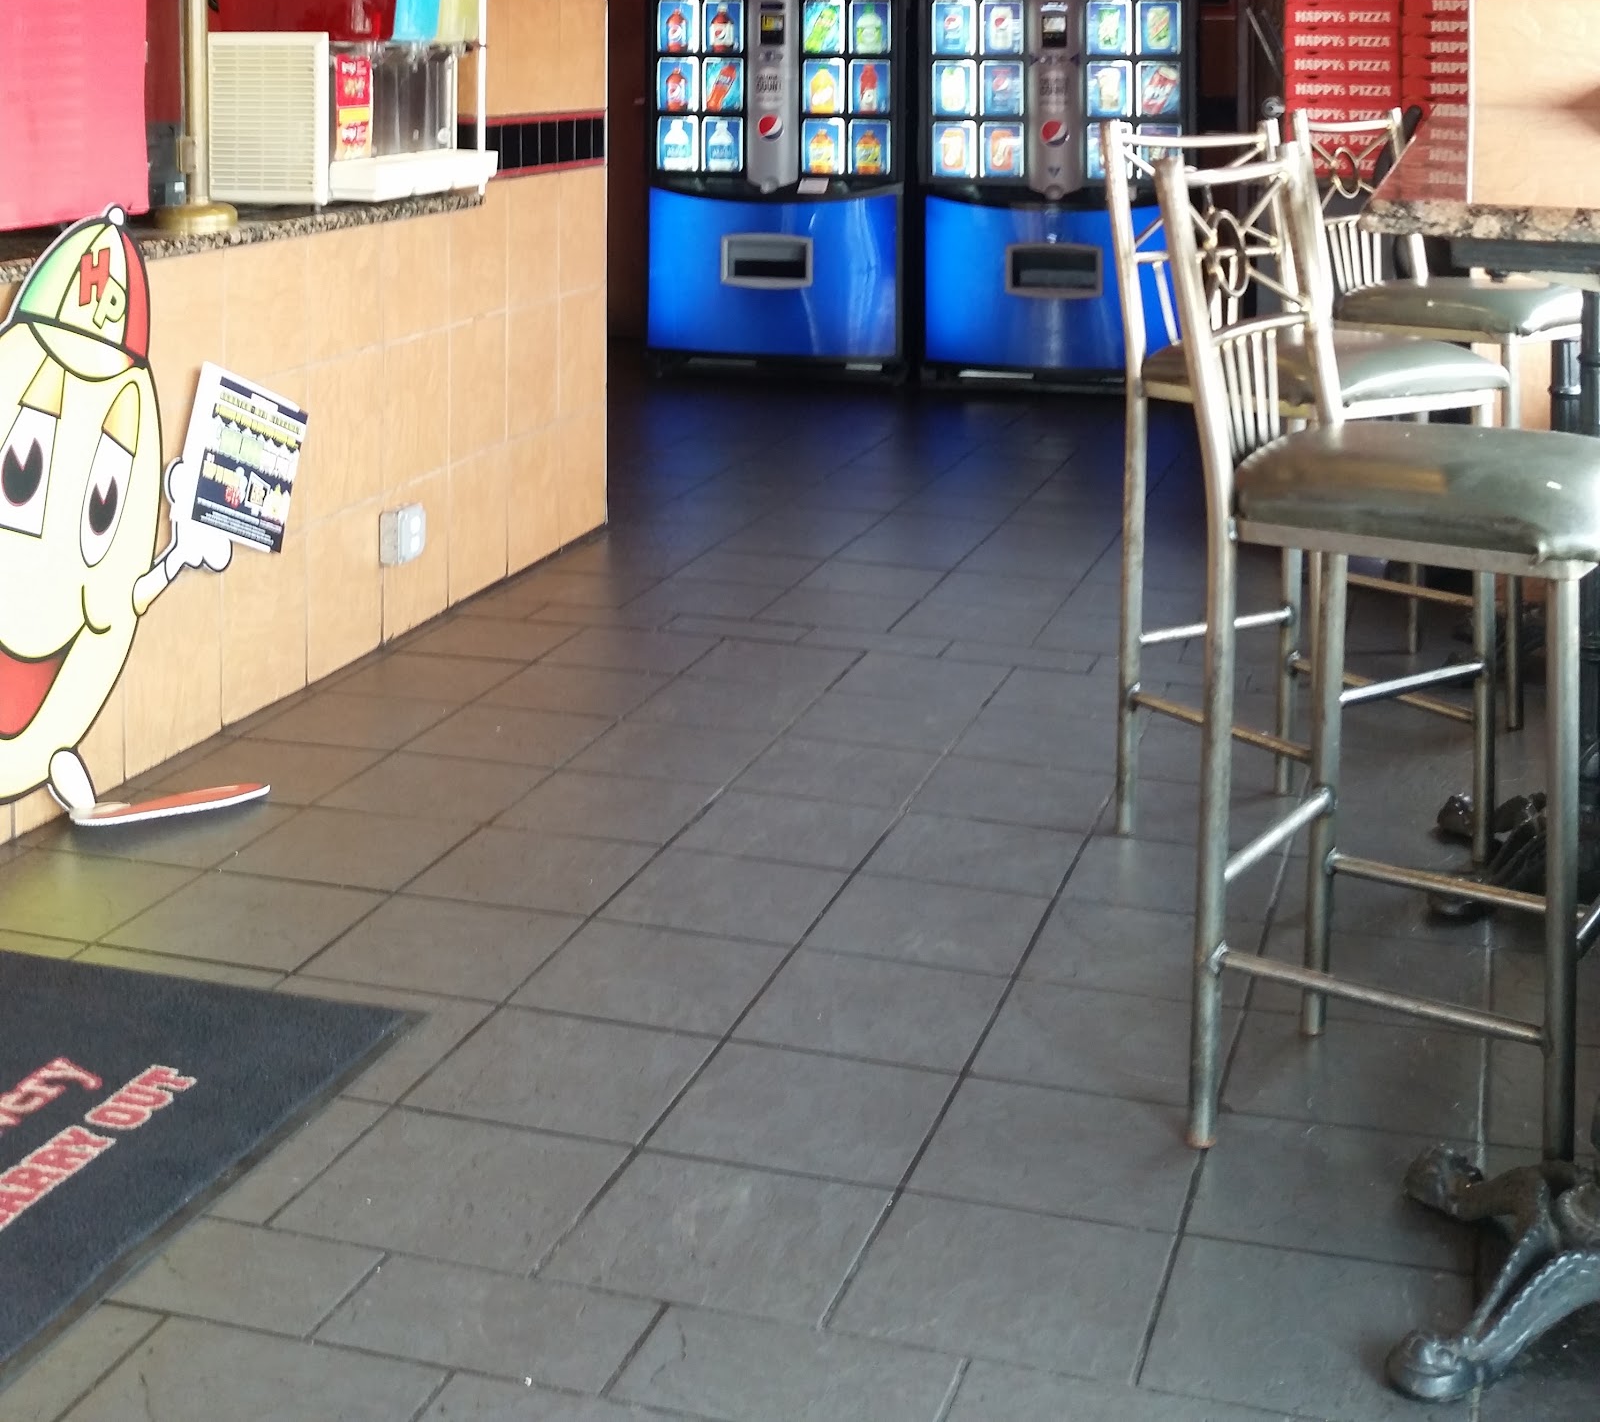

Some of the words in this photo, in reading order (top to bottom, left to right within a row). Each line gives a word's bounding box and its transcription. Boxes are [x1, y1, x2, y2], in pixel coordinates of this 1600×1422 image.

[1432, 0, 1469, 11] HAPP
[1349, 11, 1391, 23] PIZZA
[1431, 21, 1468, 32] HAPP
[1348, 35, 1391, 48] PIZZA
[1430, 41, 1468, 53] HAPP
[1348, 59, 1391, 72] PIZZA
[1431, 62, 1468, 74] HAPP
[1349, 84, 1392, 97] PIZZA
[1430, 83, 1468, 95] HAPP
[0, 1125, 116, 1232] ARRY
[84, 1064, 197, 1130] OUT
